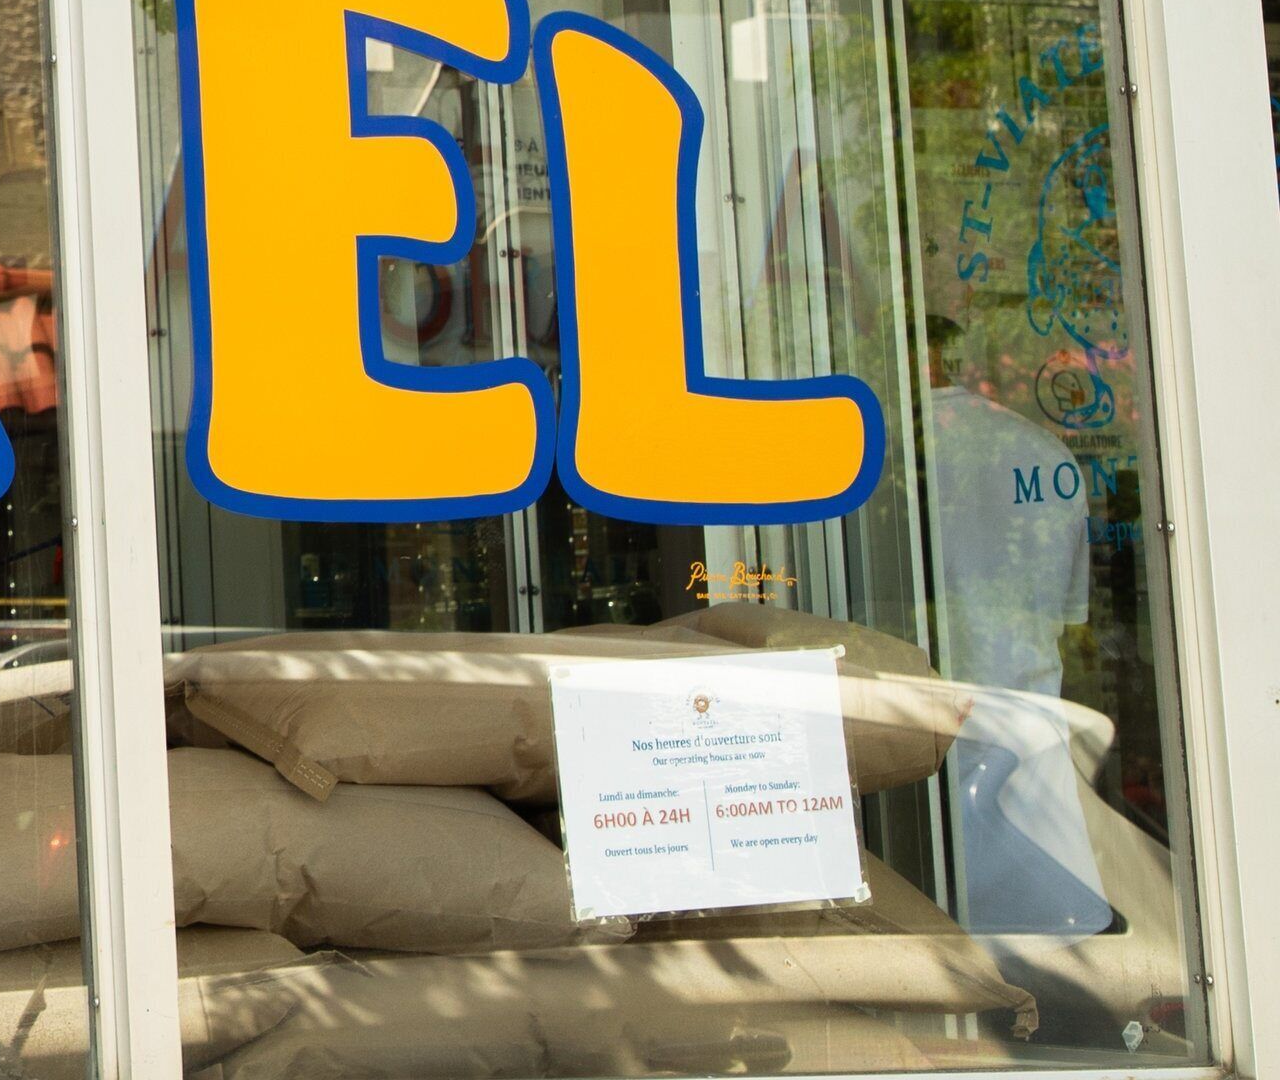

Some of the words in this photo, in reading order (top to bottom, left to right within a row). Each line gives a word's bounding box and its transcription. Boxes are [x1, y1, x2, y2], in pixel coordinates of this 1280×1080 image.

[632, 740, 653, 752] Nos
[656, 738, 691, 750] heures
[694, 734, 756, 748] d'ouverture
[759, 731, 782, 743] sont
[653, 756, 667, 767] Our
[669, 753, 708, 767] operating
[710, 751, 733, 762] hours
[734, 752, 746, 761] are
[748, 750, 766, 760] now
[724, 782, 757, 794] Monday
[758, 783, 768, 792] to
[599, 791, 623, 802] Lundi
[624, 792, 635, 800] au
[715, 801, 774, 819] 6:00AM
[776, 799, 798, 814] TO
[802, 795, 844, 812] 12AM
[593, 811, 637, 829] 6H00
[642, 806, 655, 826] À
[659, 808, 691, 825] 24H
[730, 839, 744, 849] We
[745, 839, 759, 848] are
[759, 838, 780, 848] open
[781, 835, 803, 846] every
[803, 833, 819, 844] day
[604, 846, 633, 858] Ouvert
[634, 846, 653, 856] tous
[654, 844, 667, 854] les
[667, 843, 689, 855] jours
